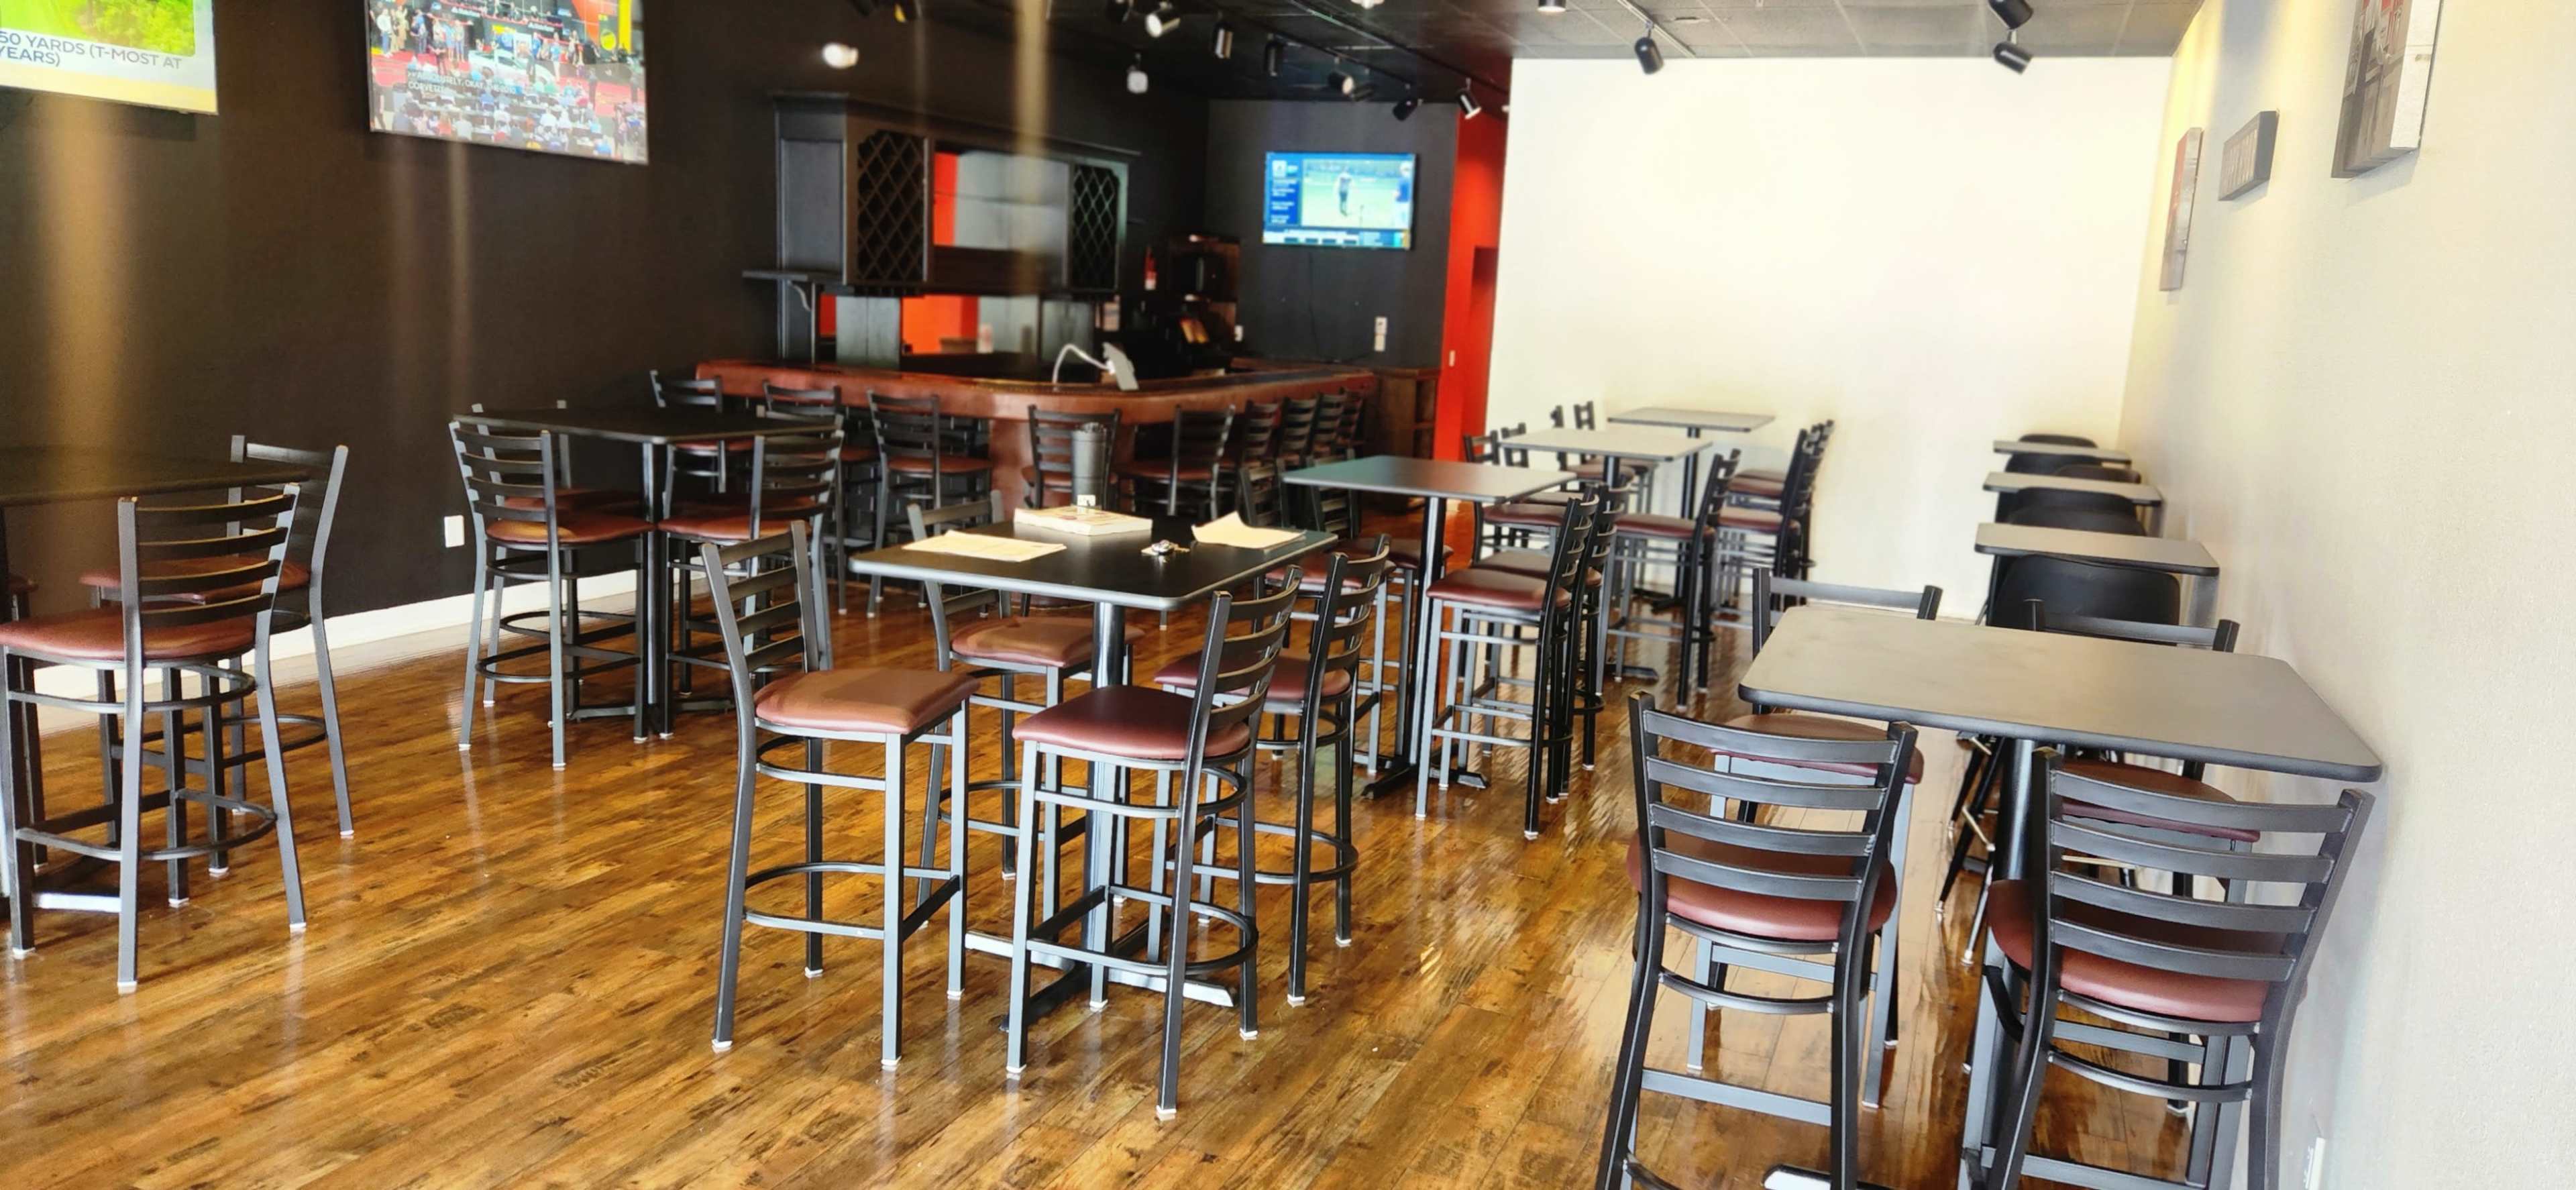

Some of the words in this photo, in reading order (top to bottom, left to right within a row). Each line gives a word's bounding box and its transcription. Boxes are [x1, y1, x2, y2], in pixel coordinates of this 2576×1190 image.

[25, 34, 86, 55] YARDS
[89, 44, 159, 66] (T-MOST
[163, 57, 182, 69] AT
